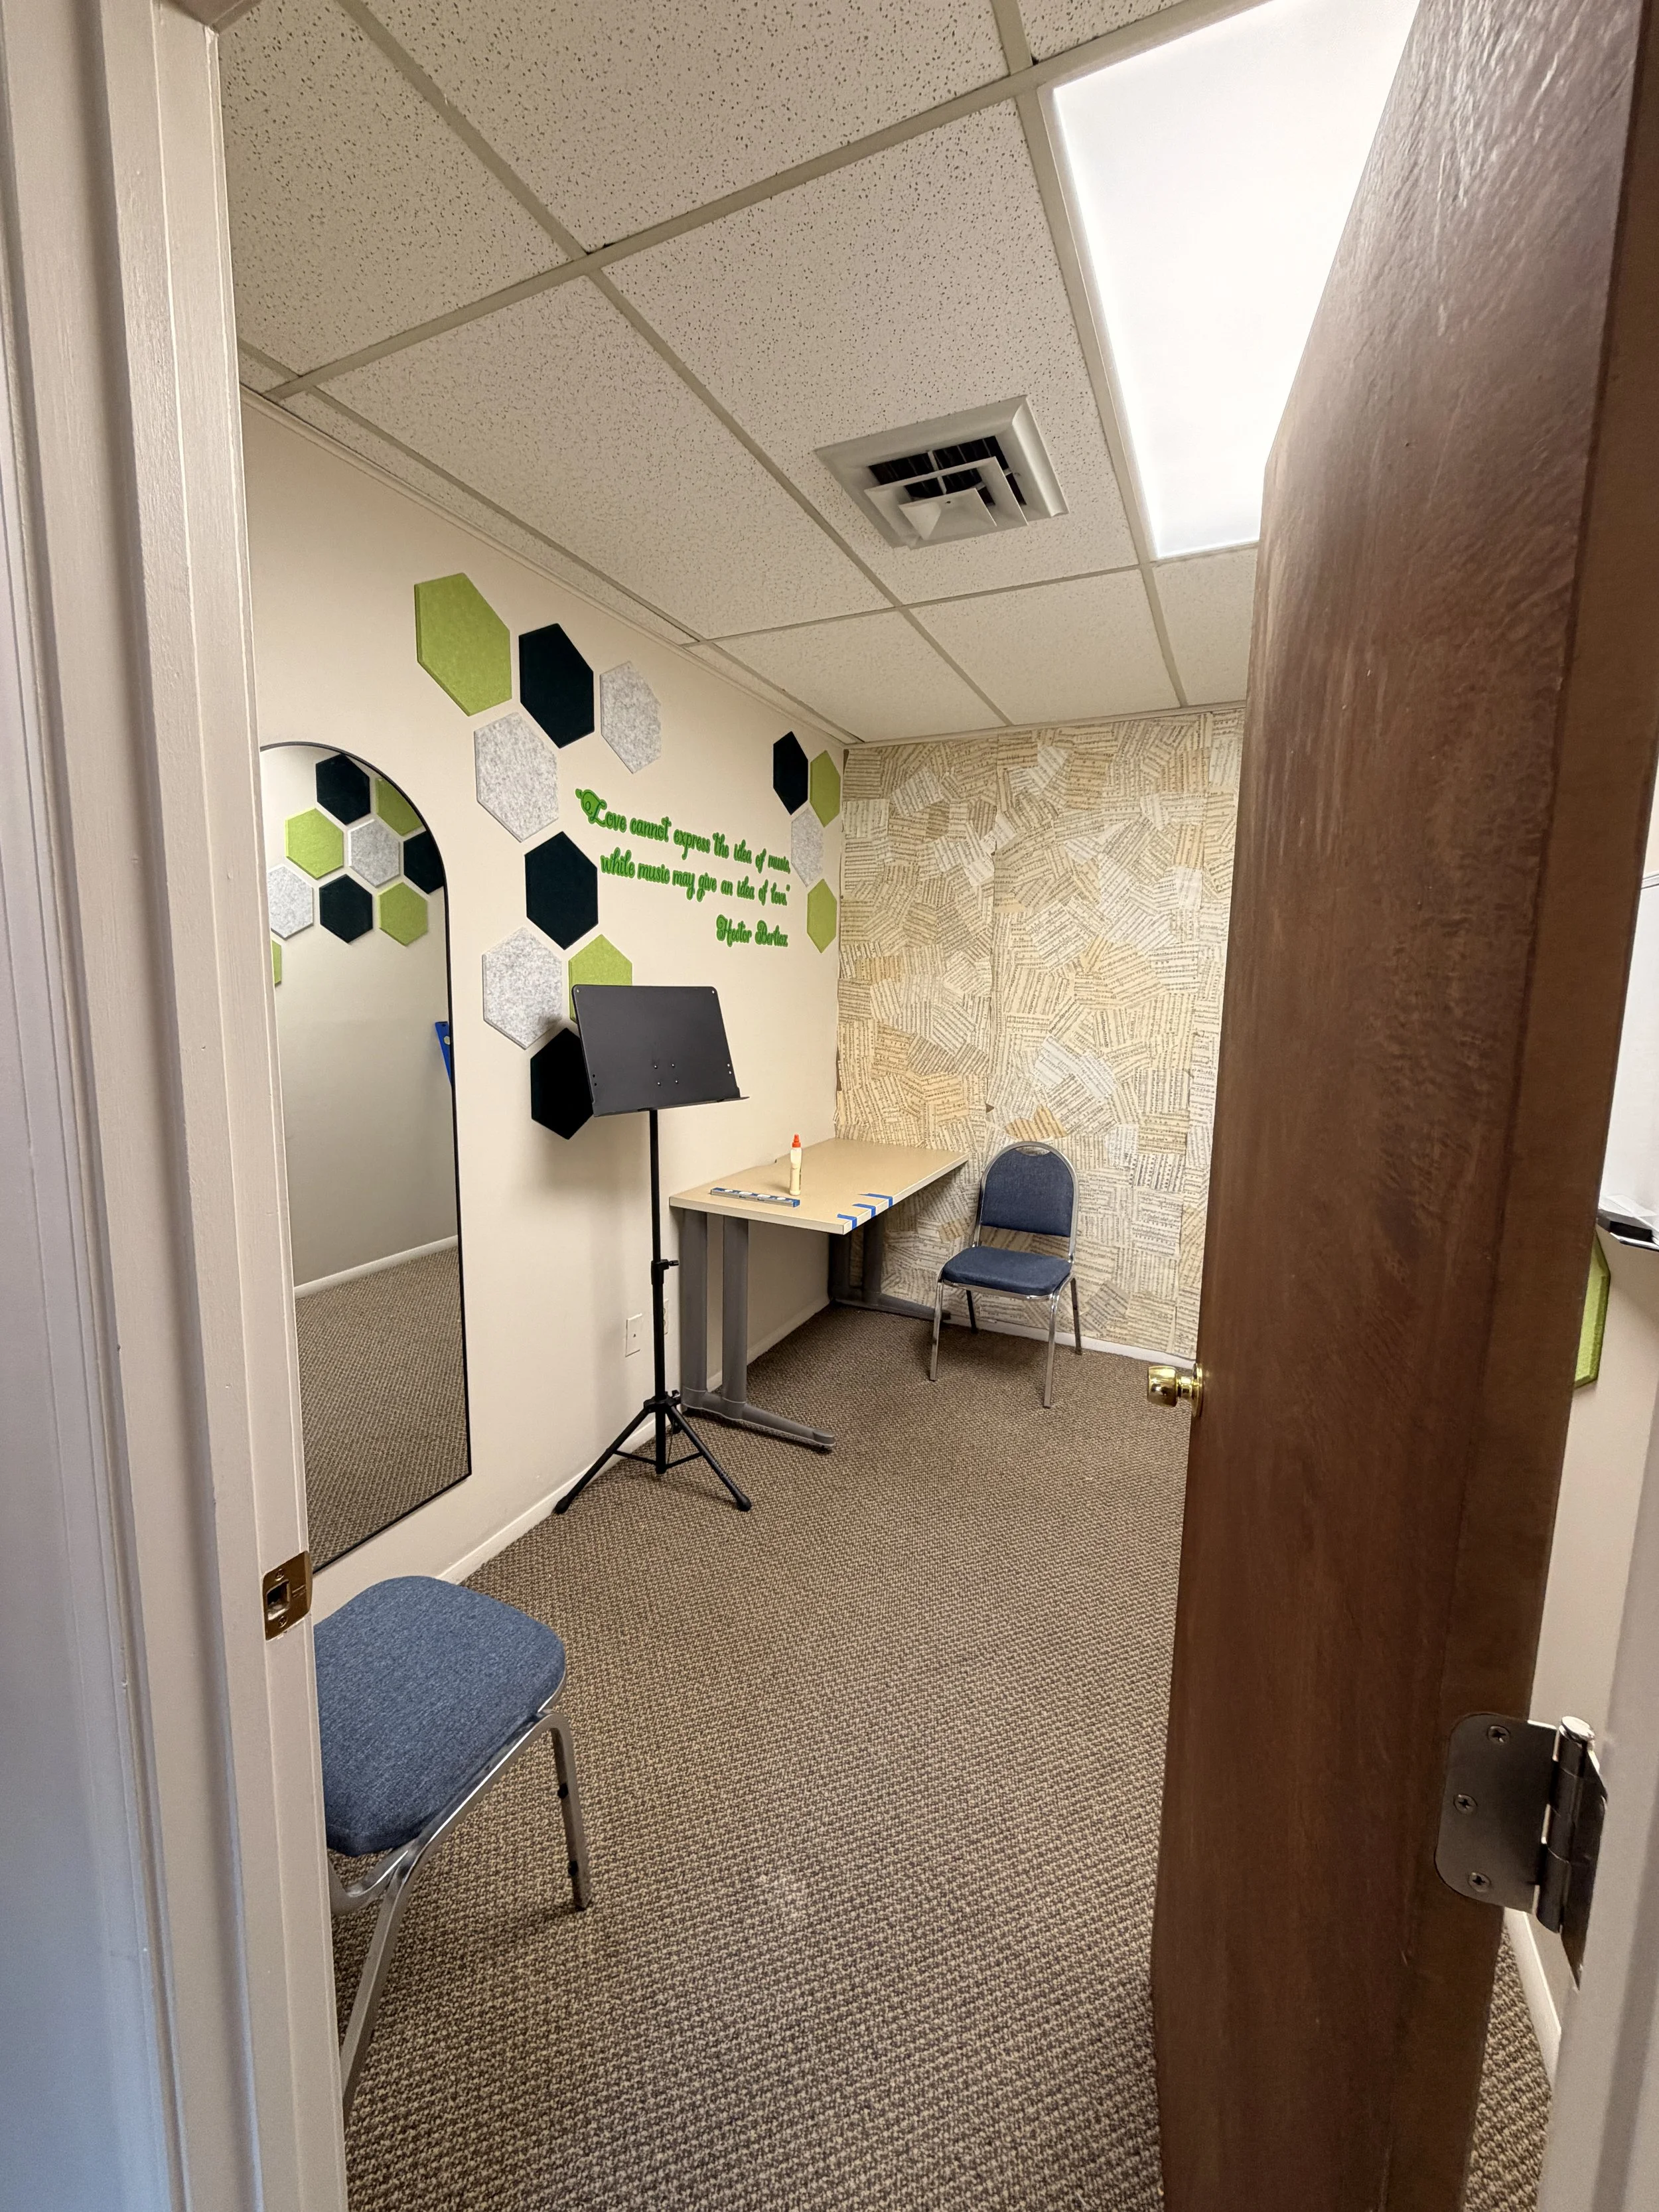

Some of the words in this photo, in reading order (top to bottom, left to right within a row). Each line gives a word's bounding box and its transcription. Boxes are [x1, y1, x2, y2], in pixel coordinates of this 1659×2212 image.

[630, 816, 672, 842] cannot
[673, 829, 711, 860] express
[712, 832, 729, 859] the
[733, 839, 752, 864] idea
[755, 848, 766, 873] of
[600, 847, 635, 879] while
[637, 863, 670, 885] music
[672, 870, 695, 901] may
[696, 872, 717, 902] give
[721, 880, 733, 896] an
[737, 875, 755, 900] idea
[758, 879, 768, 906] of
[716, 914, 753, 947] Hector
[755, 919, 788, 947] Berlioz
